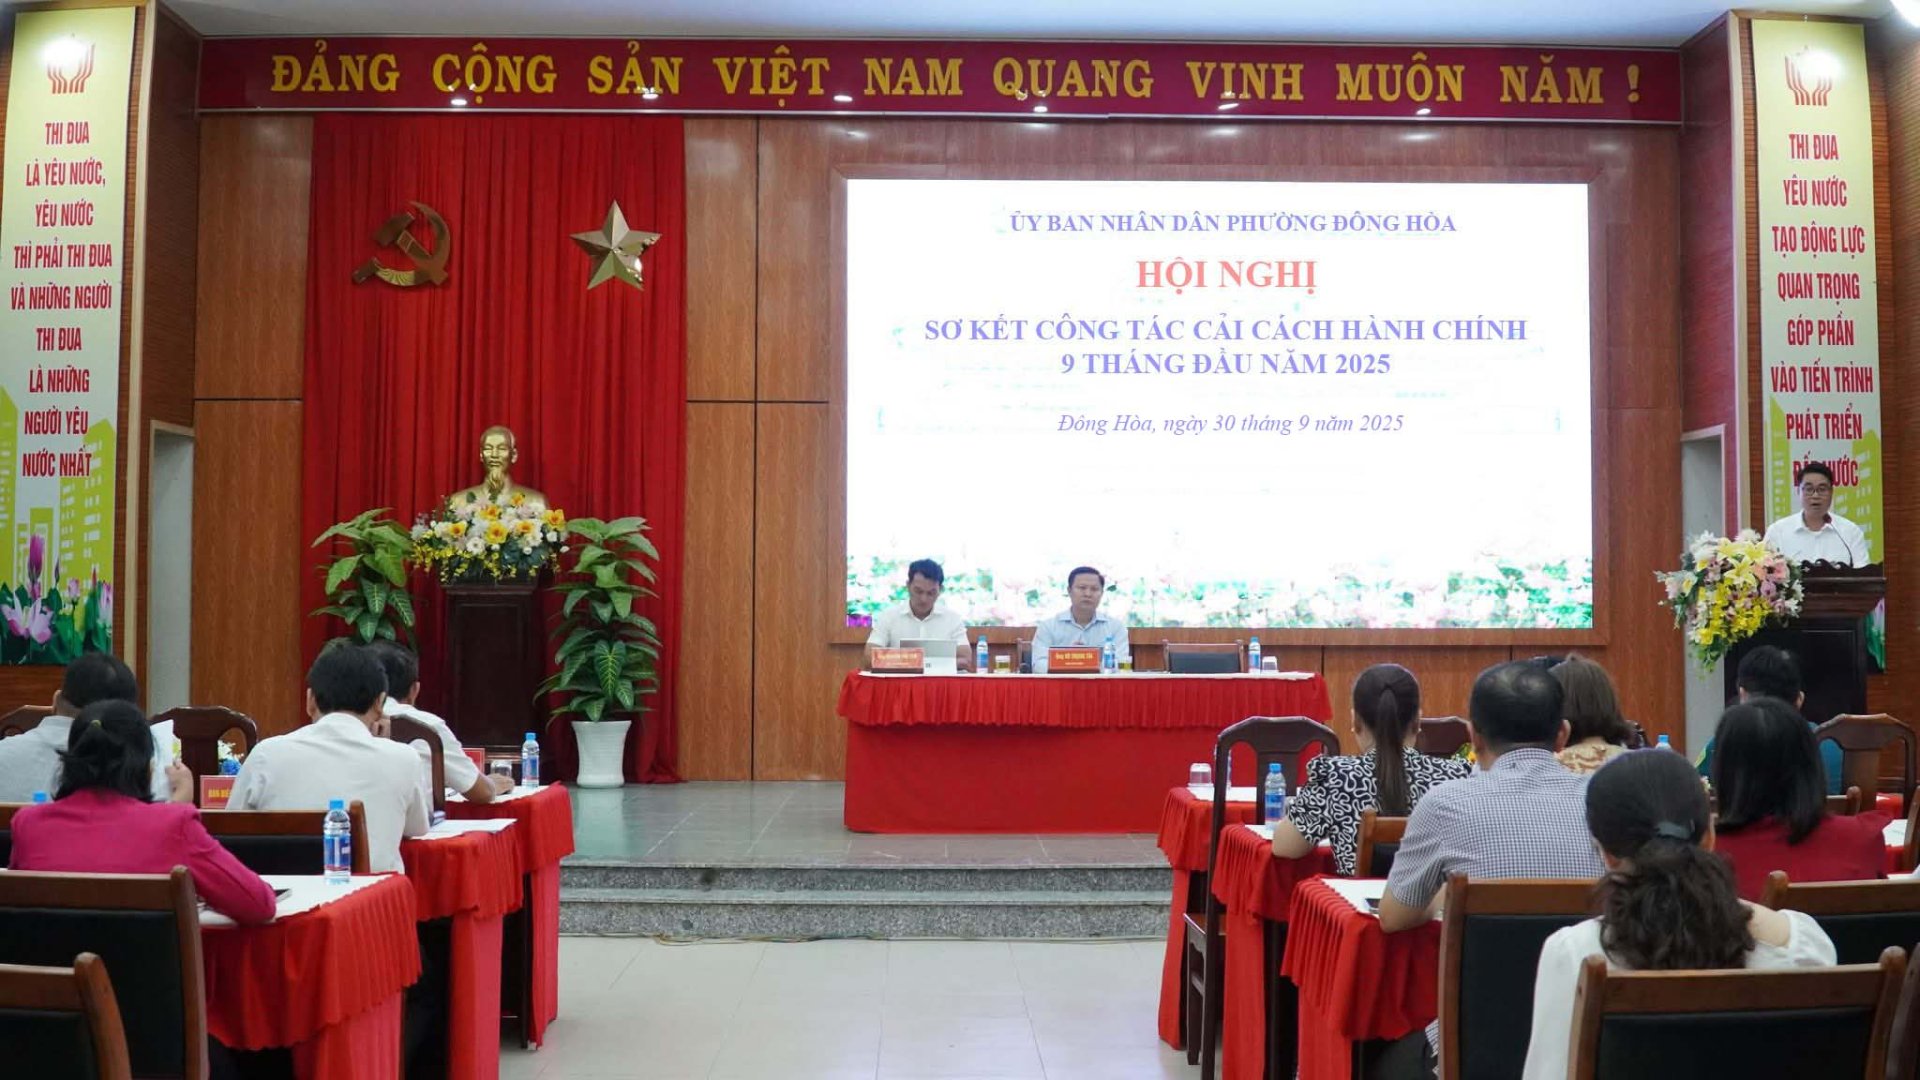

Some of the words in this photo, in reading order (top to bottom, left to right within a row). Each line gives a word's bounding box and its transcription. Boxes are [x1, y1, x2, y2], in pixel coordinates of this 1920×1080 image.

[271, 39, 399, 92] ĐẢNG
[432, 43, 557, 104] CỘNG
[587, 41, 683, 95] SẢN
[713, 45, 829, 107] VIỆT
[864, 58, 962, 96] NAM
[993, 57, 1153, 100] QUANG
[1187, 61, 1303, 101] VINH
[1337, 52, 1465, 103] MUÔN
[1501, 55, 1602, 104] NĂM
[45, 122, 63, 145] THI
[66, 121, 89, 144] ĐUA
[1789, 133, 1809, 160] THI
[1813, 134, 1839, 161] ĐUA
[26, 158, 40, 187] LÀ
[44, 158, 66, 186] YÊU
[69, 157, 106, 187] NƯỚC,
[1783, 174, 1808, 206] YÊU
[1811, 174, 1848, 207] NƯỚC
[35, 199, 57, 227] YÊU
[60, 199, 94, 226] NƯỚC
[1047, 214, 1094, 232] BAN
[1100, 210, 1166, 232] NHÂN
[1172, 210, 1220, 232] DÂN
[1226, 211, 1326, 233] PHƯỜNG
[1332, 210, 1400, 233] ĐÔNG
[1406, 211, 1457, 233] HÒA
[14, 241, 32, 269] THÌ
[35, 236, 63, 268] PHẢI
[67, 244, 85, 267] THI
[88, 243, 112, 268] ĐUA
[1772, 225, 1798, 258] TẠO
[1800, 221, 1837, 259] ĐỘNG
[1840, 224, 1866, 260] LỰC
[1136, 256, 1207, 296] HỘI
[1218, 259, 1318, 296] NGHỊ
[1777, 273, 1814, 302] QUAN
[1816, 273, 1861, 306] TRỌNG
[11, 282, 25, 310] VÀ
[29, 281, 71, 310] NHỮNG
[74, 279, 112, 309] NGƯỜI
[36, 327, 54, 351] THI
[58, 327, 82, 351] ĐUA
[924, 318, 964, 341] SƠ
[969, 312, 1029, 341] KẾT
[1035, 312, 1120, 342] CÔNG
[1126, 312, 1185, 342] TÁC
[1192, 312, 1244, 342] CẢI
[1251, 312, 1334, 342] CÁCH
[1341, 312, 1426, 342] HÀNH
[1432, 312, 1528, 342] CHÍNH
[1787, 314, 1814, 346] GÓP
[1818, 310, 1855, 346] PHẦN
[1061, 354, 1076, 376] 9
[1082, 347, 1186, 376] THÁNG
[1192, 347, 1254, 376] ĐẦU
[1260, 347, 1328, 376] NĂM
[1335, 353, 1392, 376] 2025
[1771, 361, 1798, 393] VÀO
[1801, 357, 1832, 393] TIẾN
[1834, 361, 1874, 393] TRÌNH
[29, 364, 43, 393] LÀ
[47, 364, 90, 393] NHỮNG
[24, 406, 61, 435] NGƯỜI
[65, 406, 89, 435] YÊU
[1057, 413, 1108, 437] Đông
[1112, 413, 1157, 437] Hòa,
[1163, 414, 1209, 437] ngày
[1213, 414, 1236, 433] 30
[1241, 413, 1294, 437] tháng
[1298, 415, 1311, 433] 9
[1315, 415, 1356, 433] năm
[1360, 414, 1405, 433] 2025
[1786, 408, 1821, 439] PHÁT
[1824, 403, 1863, 440] TRIỂN
[22, 448, 56, 477] NƯỚC
[59, 445, 92, 477] NHẤT
